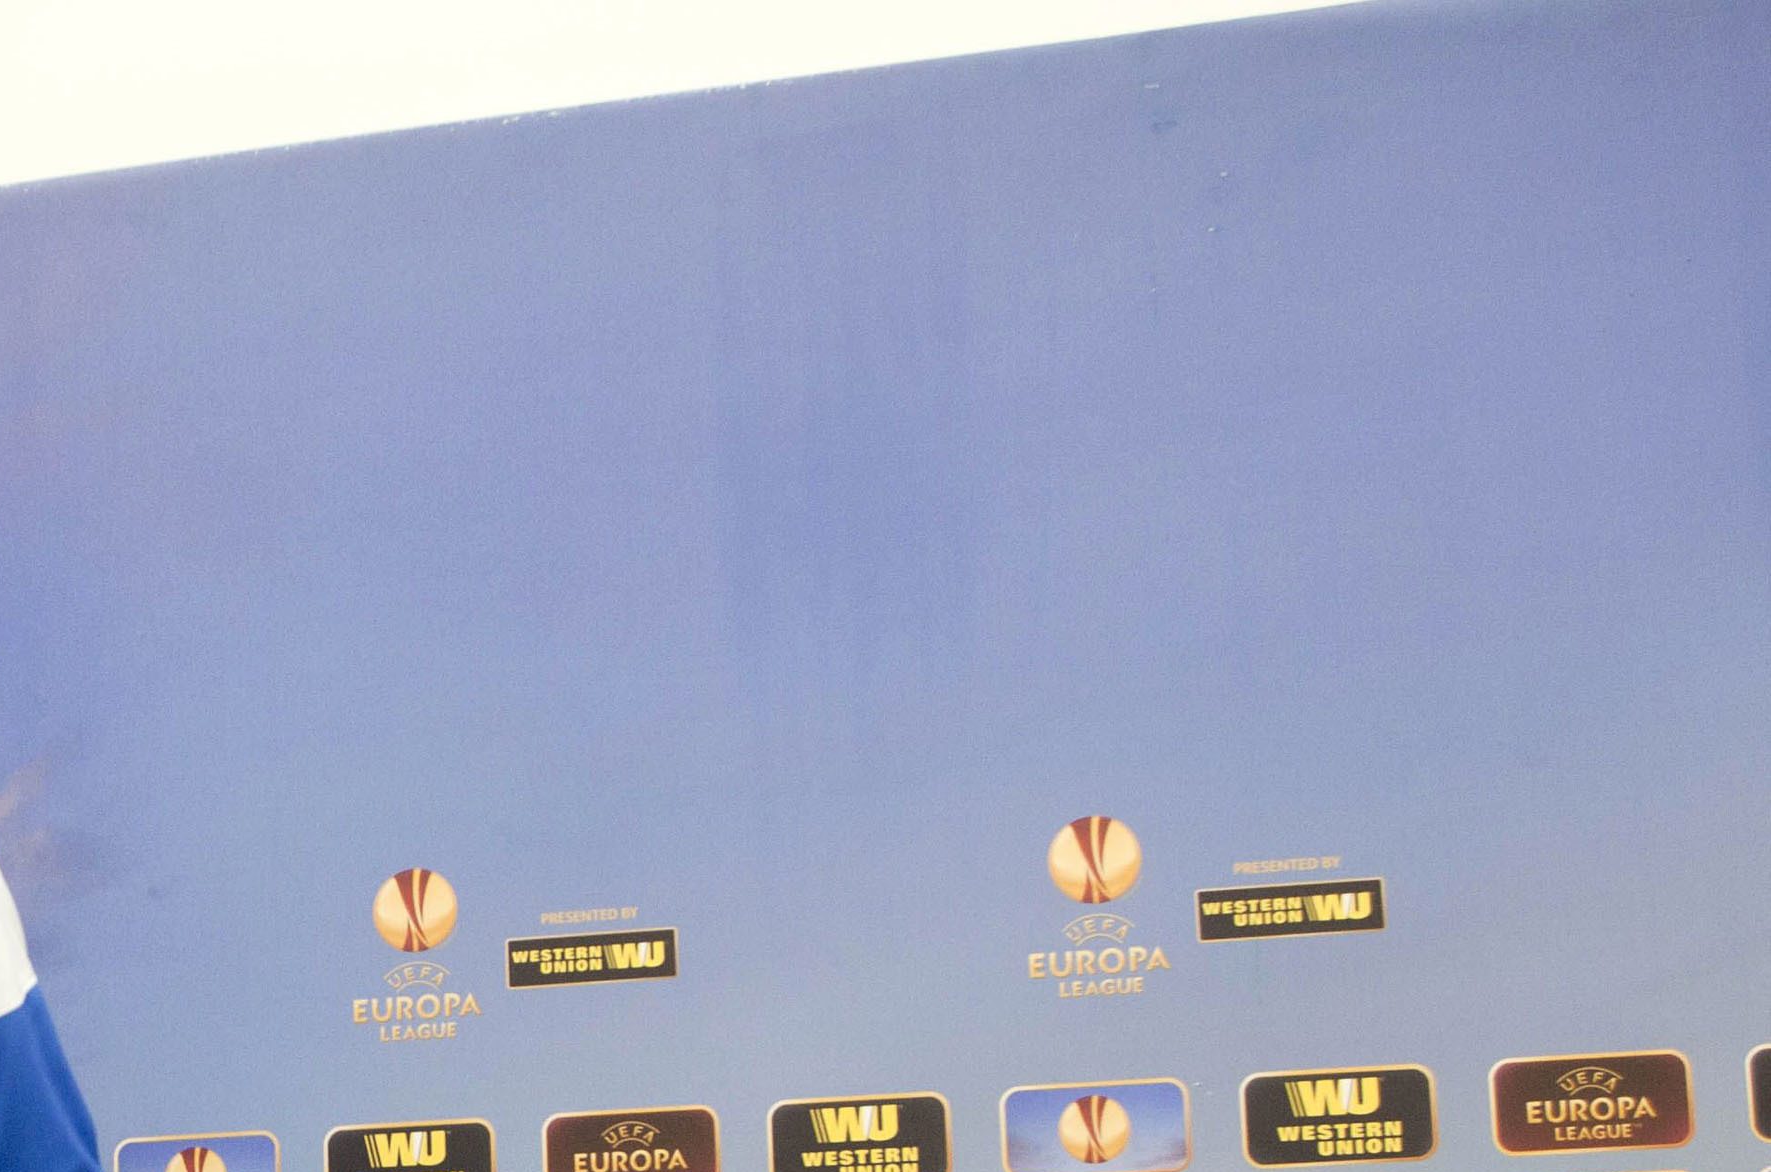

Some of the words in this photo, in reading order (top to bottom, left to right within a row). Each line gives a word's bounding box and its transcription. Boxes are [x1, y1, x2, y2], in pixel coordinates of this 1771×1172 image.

[1233, 857, 1318, 875] PRESENTED
[1322, 857, 1340, 869] BY
[540, 907, 617, 925] PRESENTED
[621, 906, 638, 919] BY
[1202, 897, 1302, 915] WESTERN
[1311, 892, 1371, 921] WU
[1066, 917, 1127, 941] UEFA
[1234, 910, 1303, 927] UNION
[511, 945, 602, 964] WESTERN
[612, 941, 665, 969] WU
[1028, 946, 1171, 979] EUROPA
[386, 965, 445, 988] UEFA
[539, 958, 602, 975] UNION
[1059, 977, 1143, 998] LEAGUE
[352, 993, 482, 1024] EUROPA
[380, 1022, 457, 1043] LEAGUE
[1557, 1071, 1618, 1093] UEFA
[1297, 1076, 1381, 1117] WU
[1525, 1096, 1657, 1125] EUROPA
[821, 1104, 899, 1143] WU
[1277, 1120, 1402, 1142] WESTERN
[1554, 1123, 1632, 1142] LEAGUE
[604, 1125, 655, 1145] UEFA
[375, 1129, 447, 1168] WU
[801, 1147, 919, 1167] WESTERN
[1317, 1137, 1402, 1157] UNION
